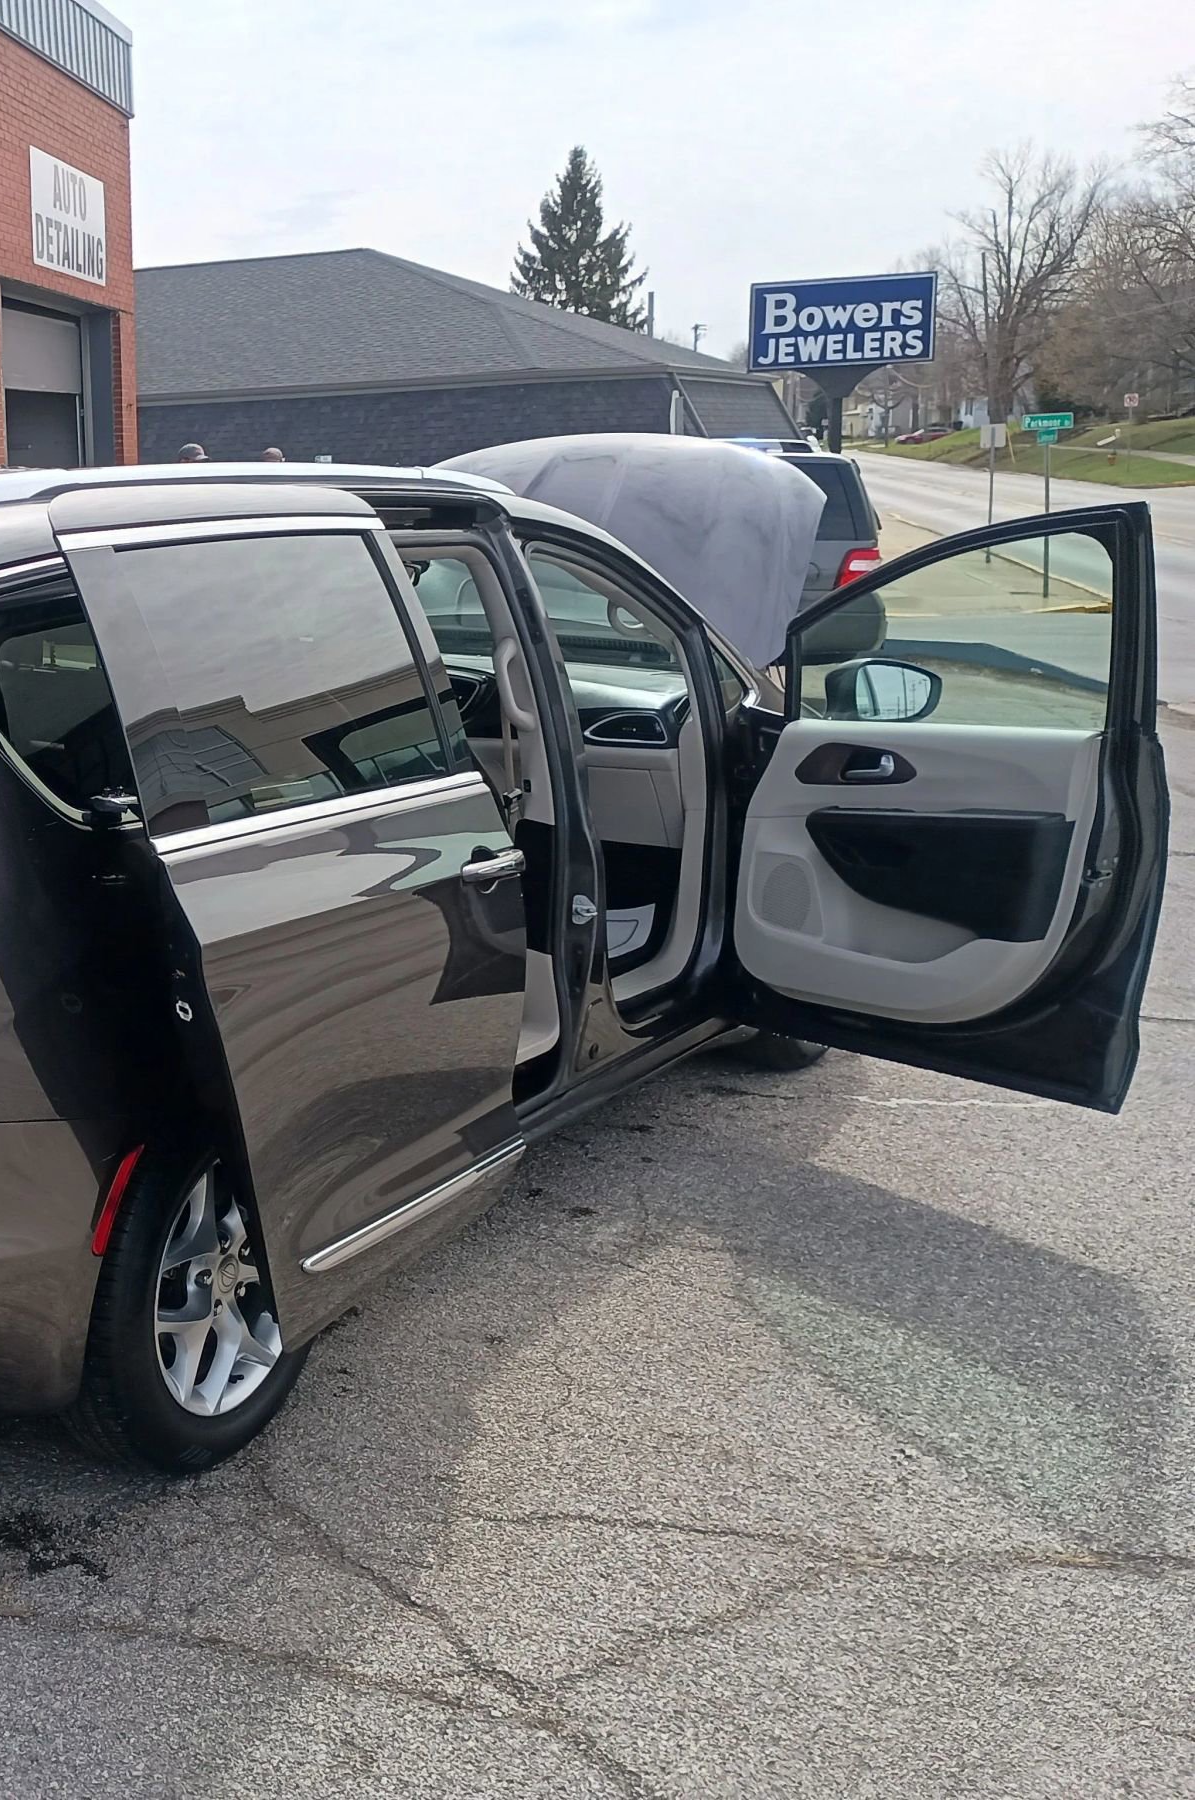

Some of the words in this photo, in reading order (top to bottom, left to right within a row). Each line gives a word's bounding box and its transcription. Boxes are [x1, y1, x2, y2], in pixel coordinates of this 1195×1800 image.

[52, 164, 87, 222] AUTO
[35, 212, 104, 280] DETAILING
[760, 292, 923, 335] Bowers
[757, 329, 924, 365] JEWELERS
